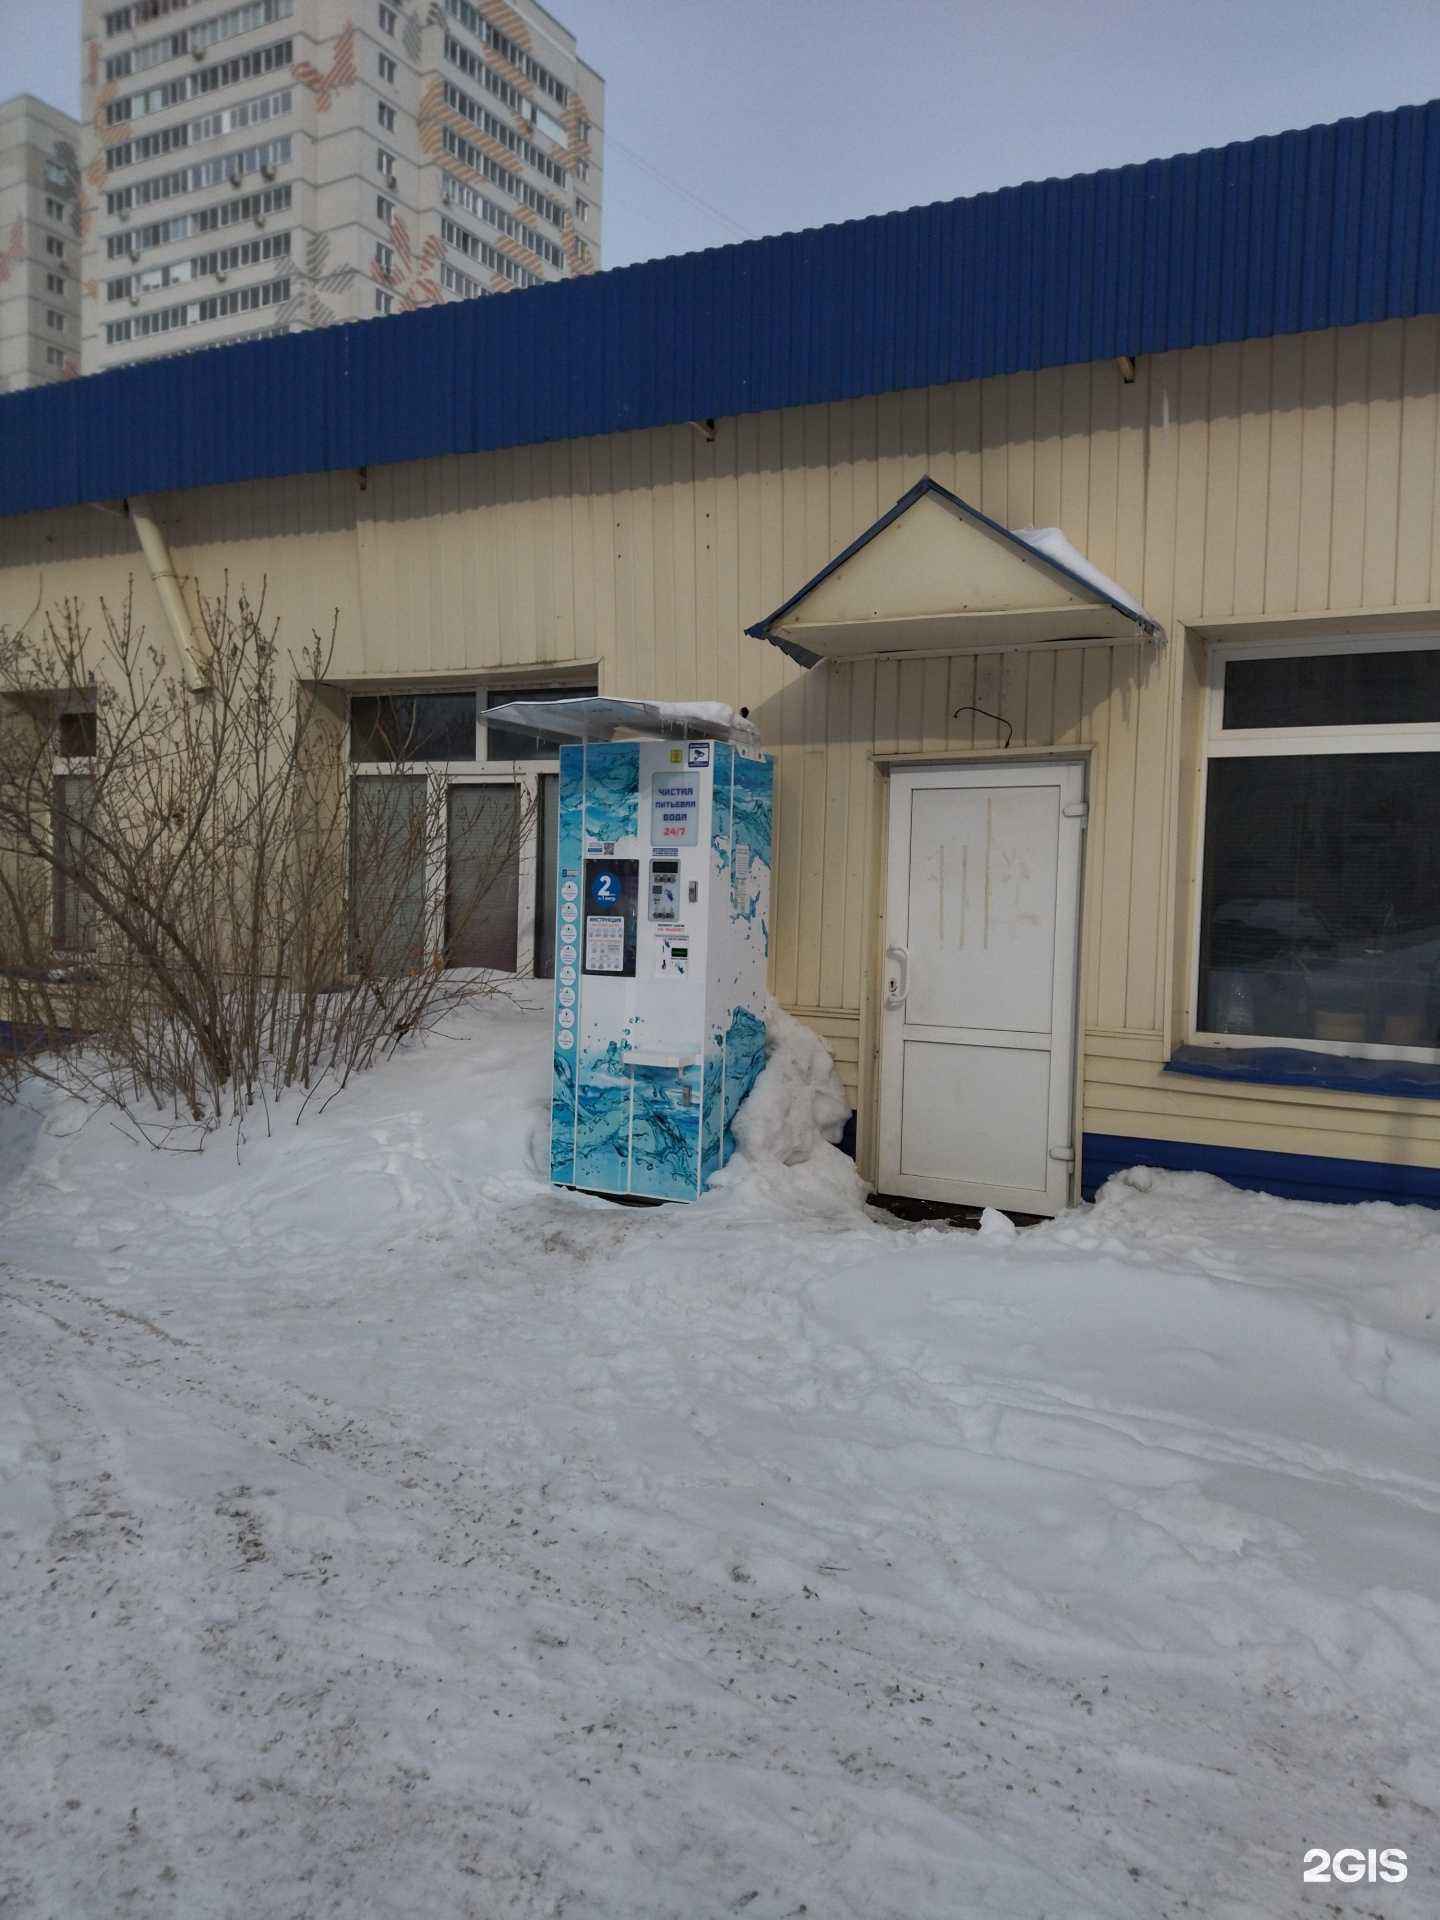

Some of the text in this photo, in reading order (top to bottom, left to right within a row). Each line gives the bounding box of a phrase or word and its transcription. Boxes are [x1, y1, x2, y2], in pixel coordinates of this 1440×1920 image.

[658, 787, 693, 797] ЧИСТАЯ
[655, 800, 696, 809] ПИТЬЕВАЯ
[663, 813, 688, 822] ВОДА
[663, 827, 686, 836] 24/7
[597, 875, 612, 896] 2
